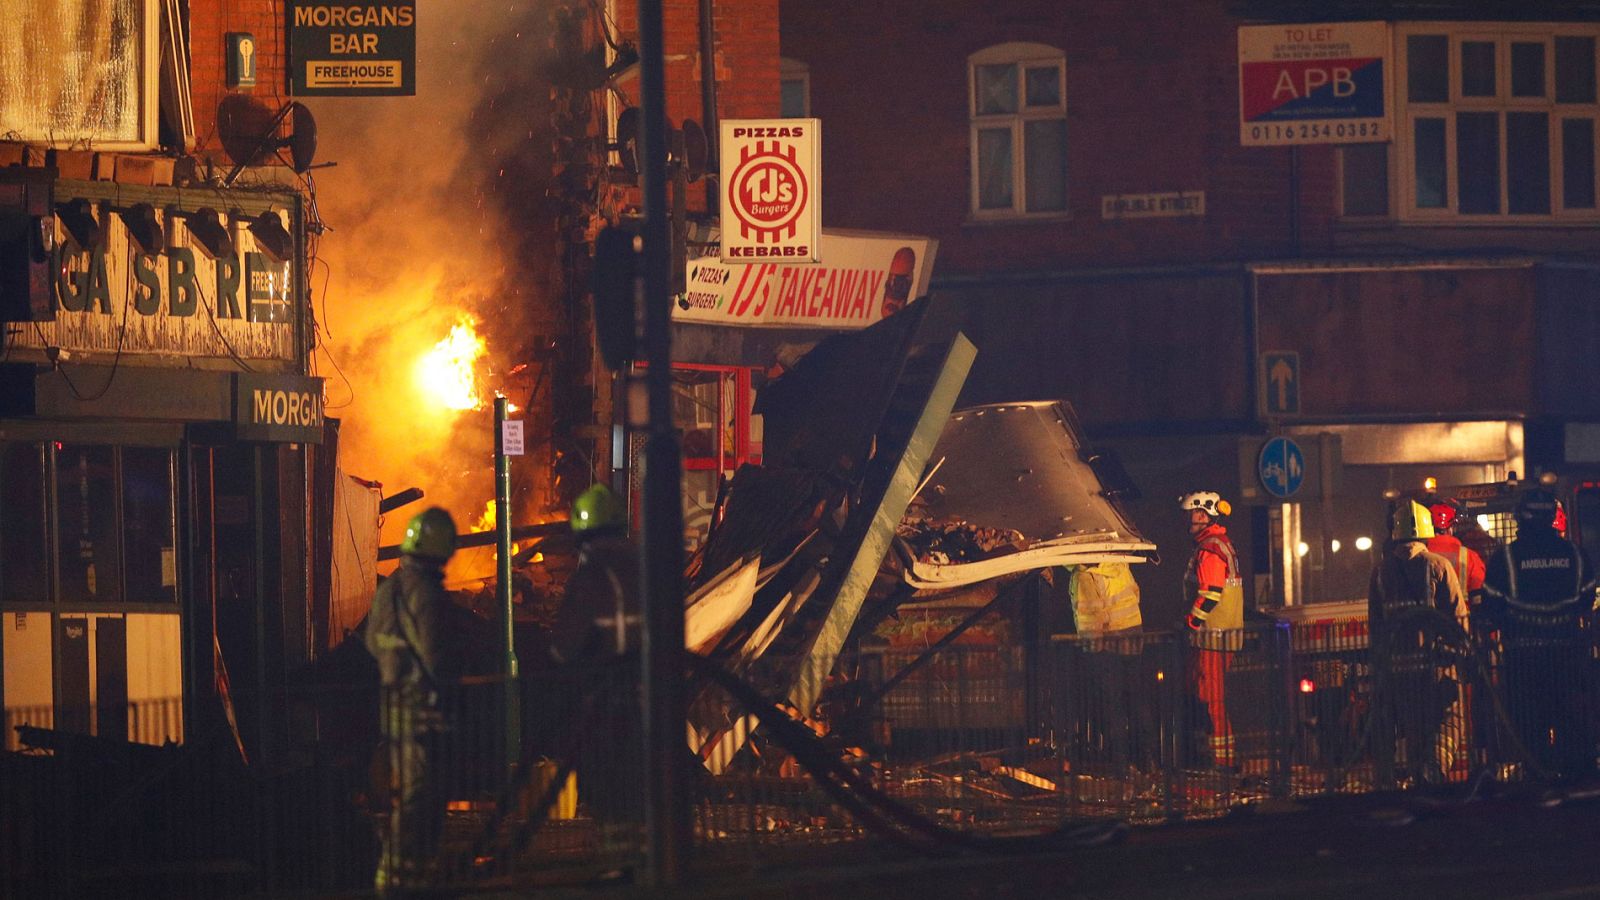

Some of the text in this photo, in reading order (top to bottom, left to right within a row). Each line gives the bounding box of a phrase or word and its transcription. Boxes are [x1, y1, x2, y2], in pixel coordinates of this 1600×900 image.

[294, 5, 414, 27] MORGANS
[329, 33, 379, 54] BAR
[1285, 29, 1335, 42] TO LET
[314, 66, 394, 78] FREEHOUSE
[1272, 67, 1356, 99] APB
[733, 127, 804, 138] PIZZAS
[1252, 123, 1379, 140] 0116 254 0382
[751, 203, 789, 216] Burgers
[729, 246, 808, 257] KEBABS
[251, 271, 291, 292] FREEOUE
[697, 267, 724, 285] PIZZAS
[687, 291, 718, 309] BURGERS
[773, 267, 884, 320] TAKEAWAY
[1521, 558, 1570, 570] AMBULANCE
